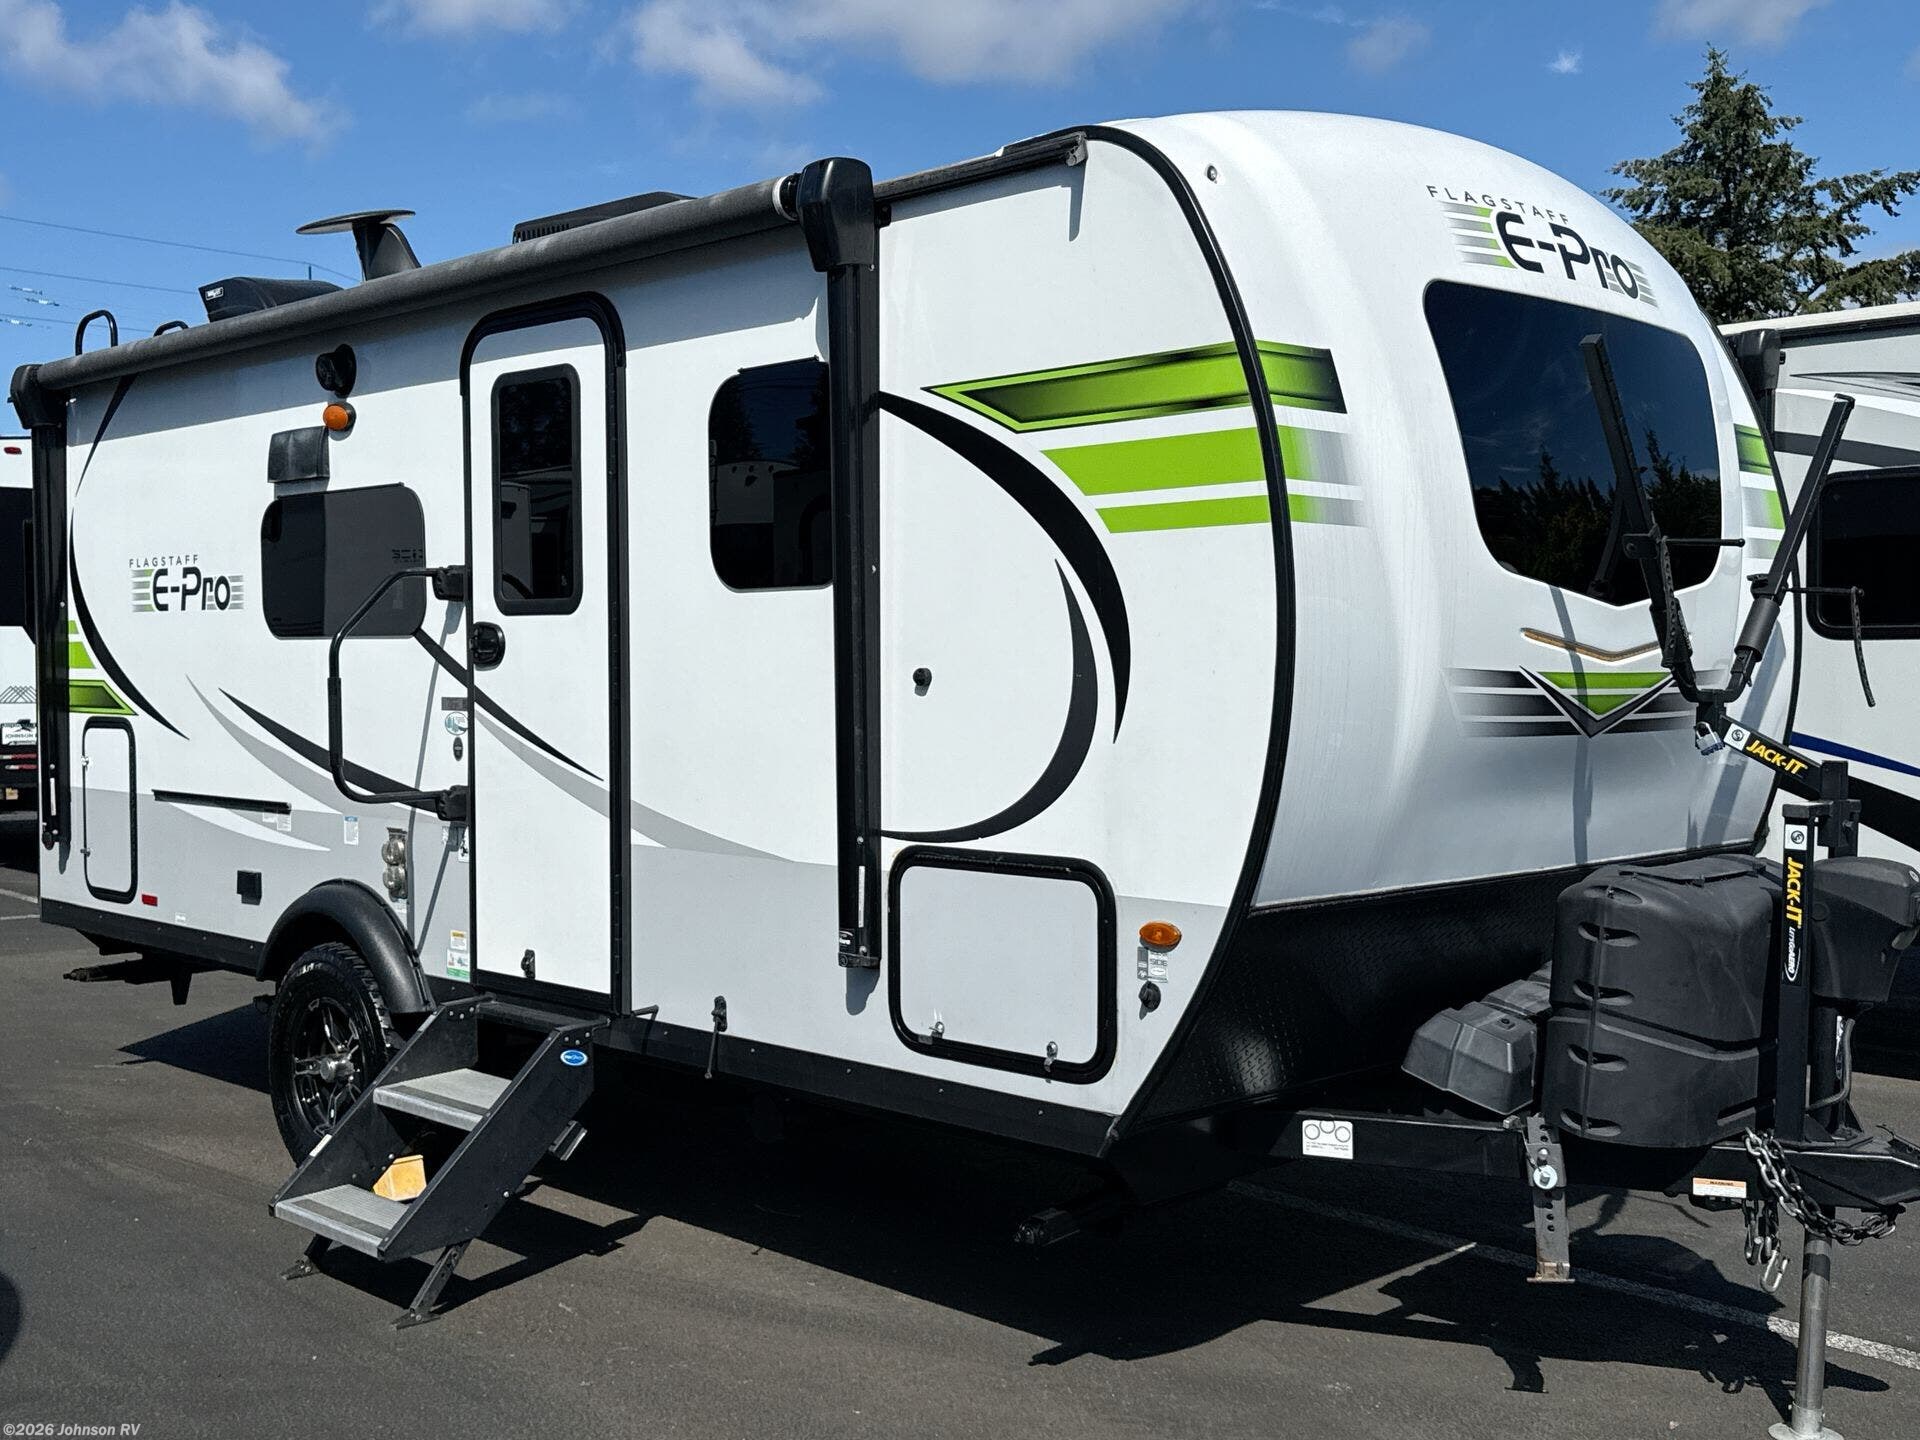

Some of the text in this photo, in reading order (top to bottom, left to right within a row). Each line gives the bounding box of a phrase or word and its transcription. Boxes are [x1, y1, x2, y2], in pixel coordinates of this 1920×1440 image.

[1426, 185, 1568, 224] FLAGSTAFF
[1496, 211, 1638, 299] E-Pro
[129, 554, 198, 568] FLAGSTAFF
[152, 566, 231, 612] E-Pro
[1746, 740, 1808, 774] JACK-IT
[1787, 857, 1804, 926] JACK-IT
